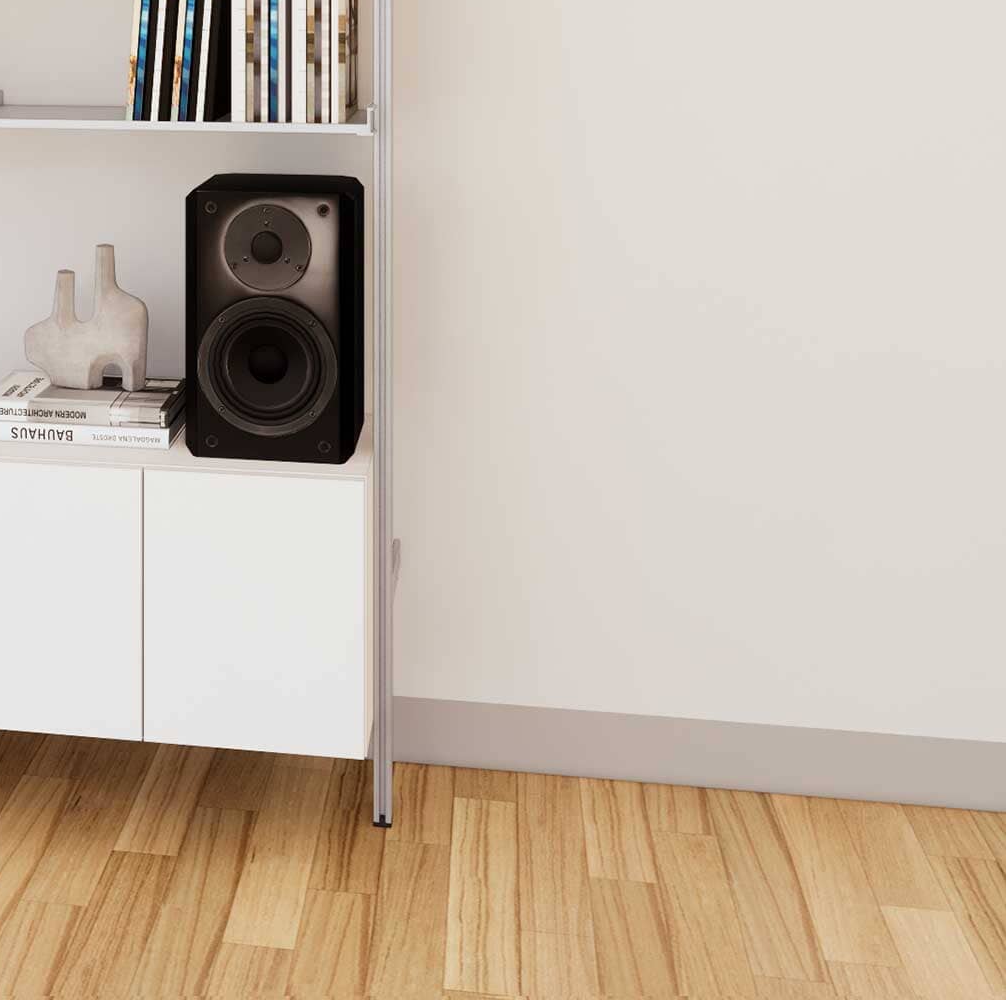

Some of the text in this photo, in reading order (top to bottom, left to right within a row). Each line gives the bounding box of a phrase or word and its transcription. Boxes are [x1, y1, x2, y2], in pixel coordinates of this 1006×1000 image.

[0, 406, 86, 420] MODERN ARCHITECTURE
[10, 426, 73, 442] BAUHAUS
[92, 434, 161, 444] MAGDALENA DROSTE
